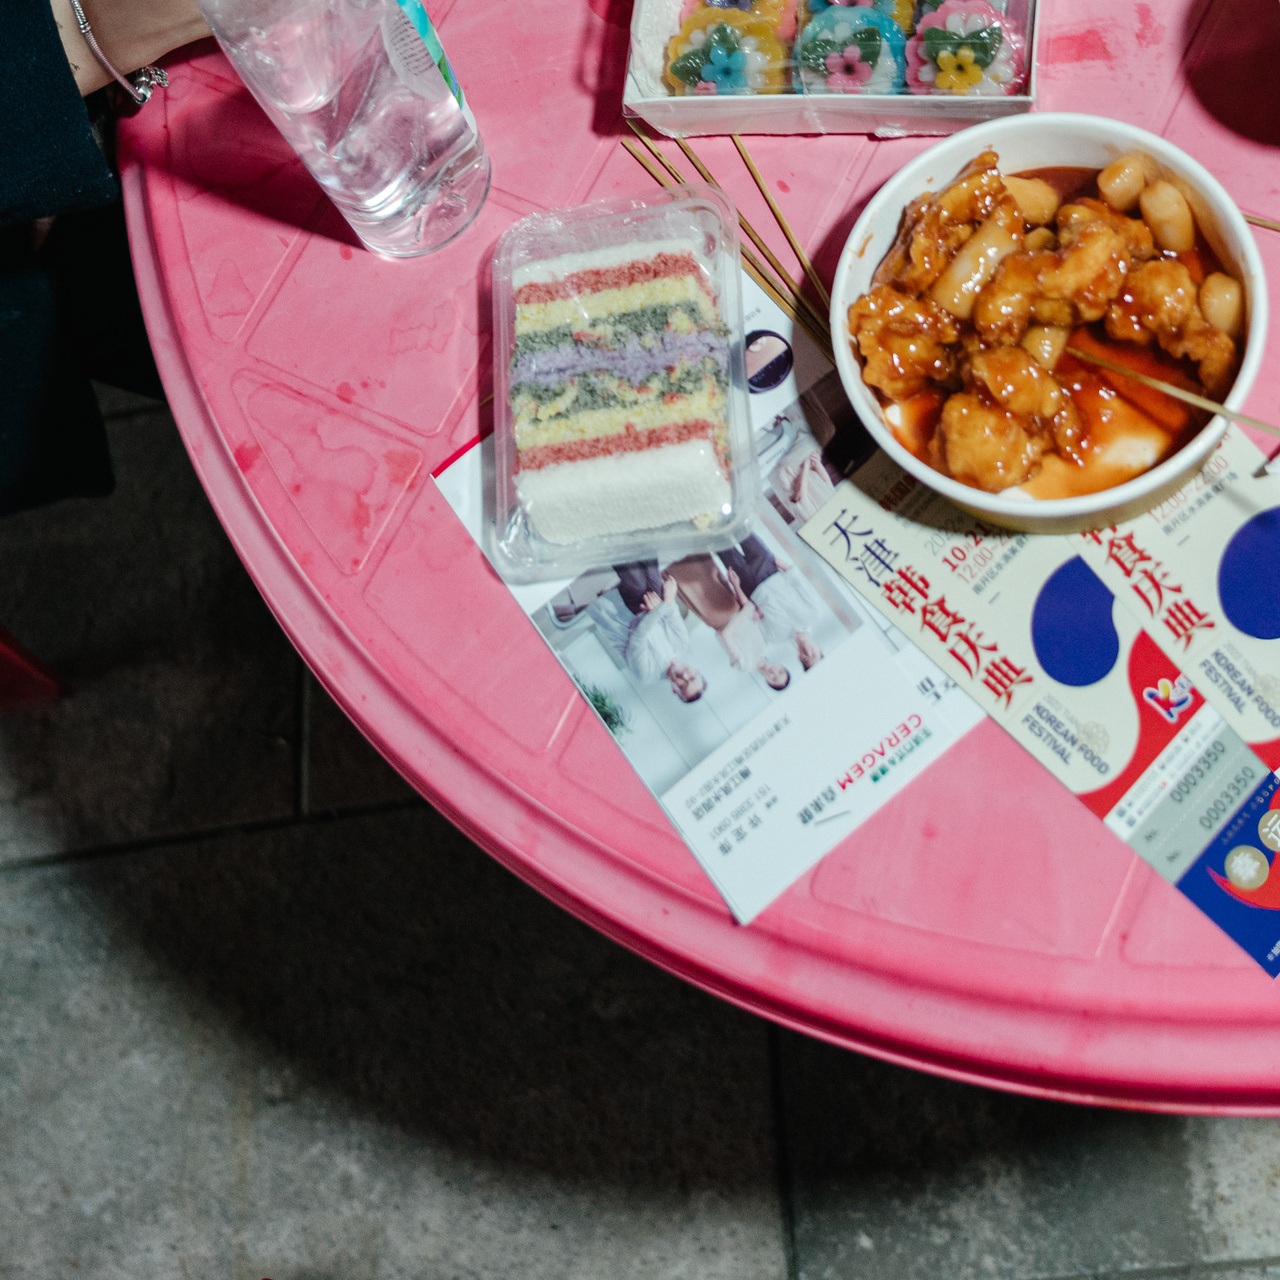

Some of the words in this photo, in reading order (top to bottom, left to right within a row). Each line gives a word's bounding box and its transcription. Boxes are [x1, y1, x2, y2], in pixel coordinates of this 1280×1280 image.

[822, 509, 1034, 710] 天津韩食庆典
[1199, 659, 1246, 713] FESTIVAL
[1210, 648, 1254, 699] KOREAN
[835, 712, 924, 790] CERAGEM
[1021, 713, 1071, 765] FESTIVAL
[1032, 701, 1079, 747] KOREAN
[1077, 742, 1110, 775] FOOD
[1170, 740, 1226, 803] 0003350
[1197, 765, 1256, 830] 0003350
